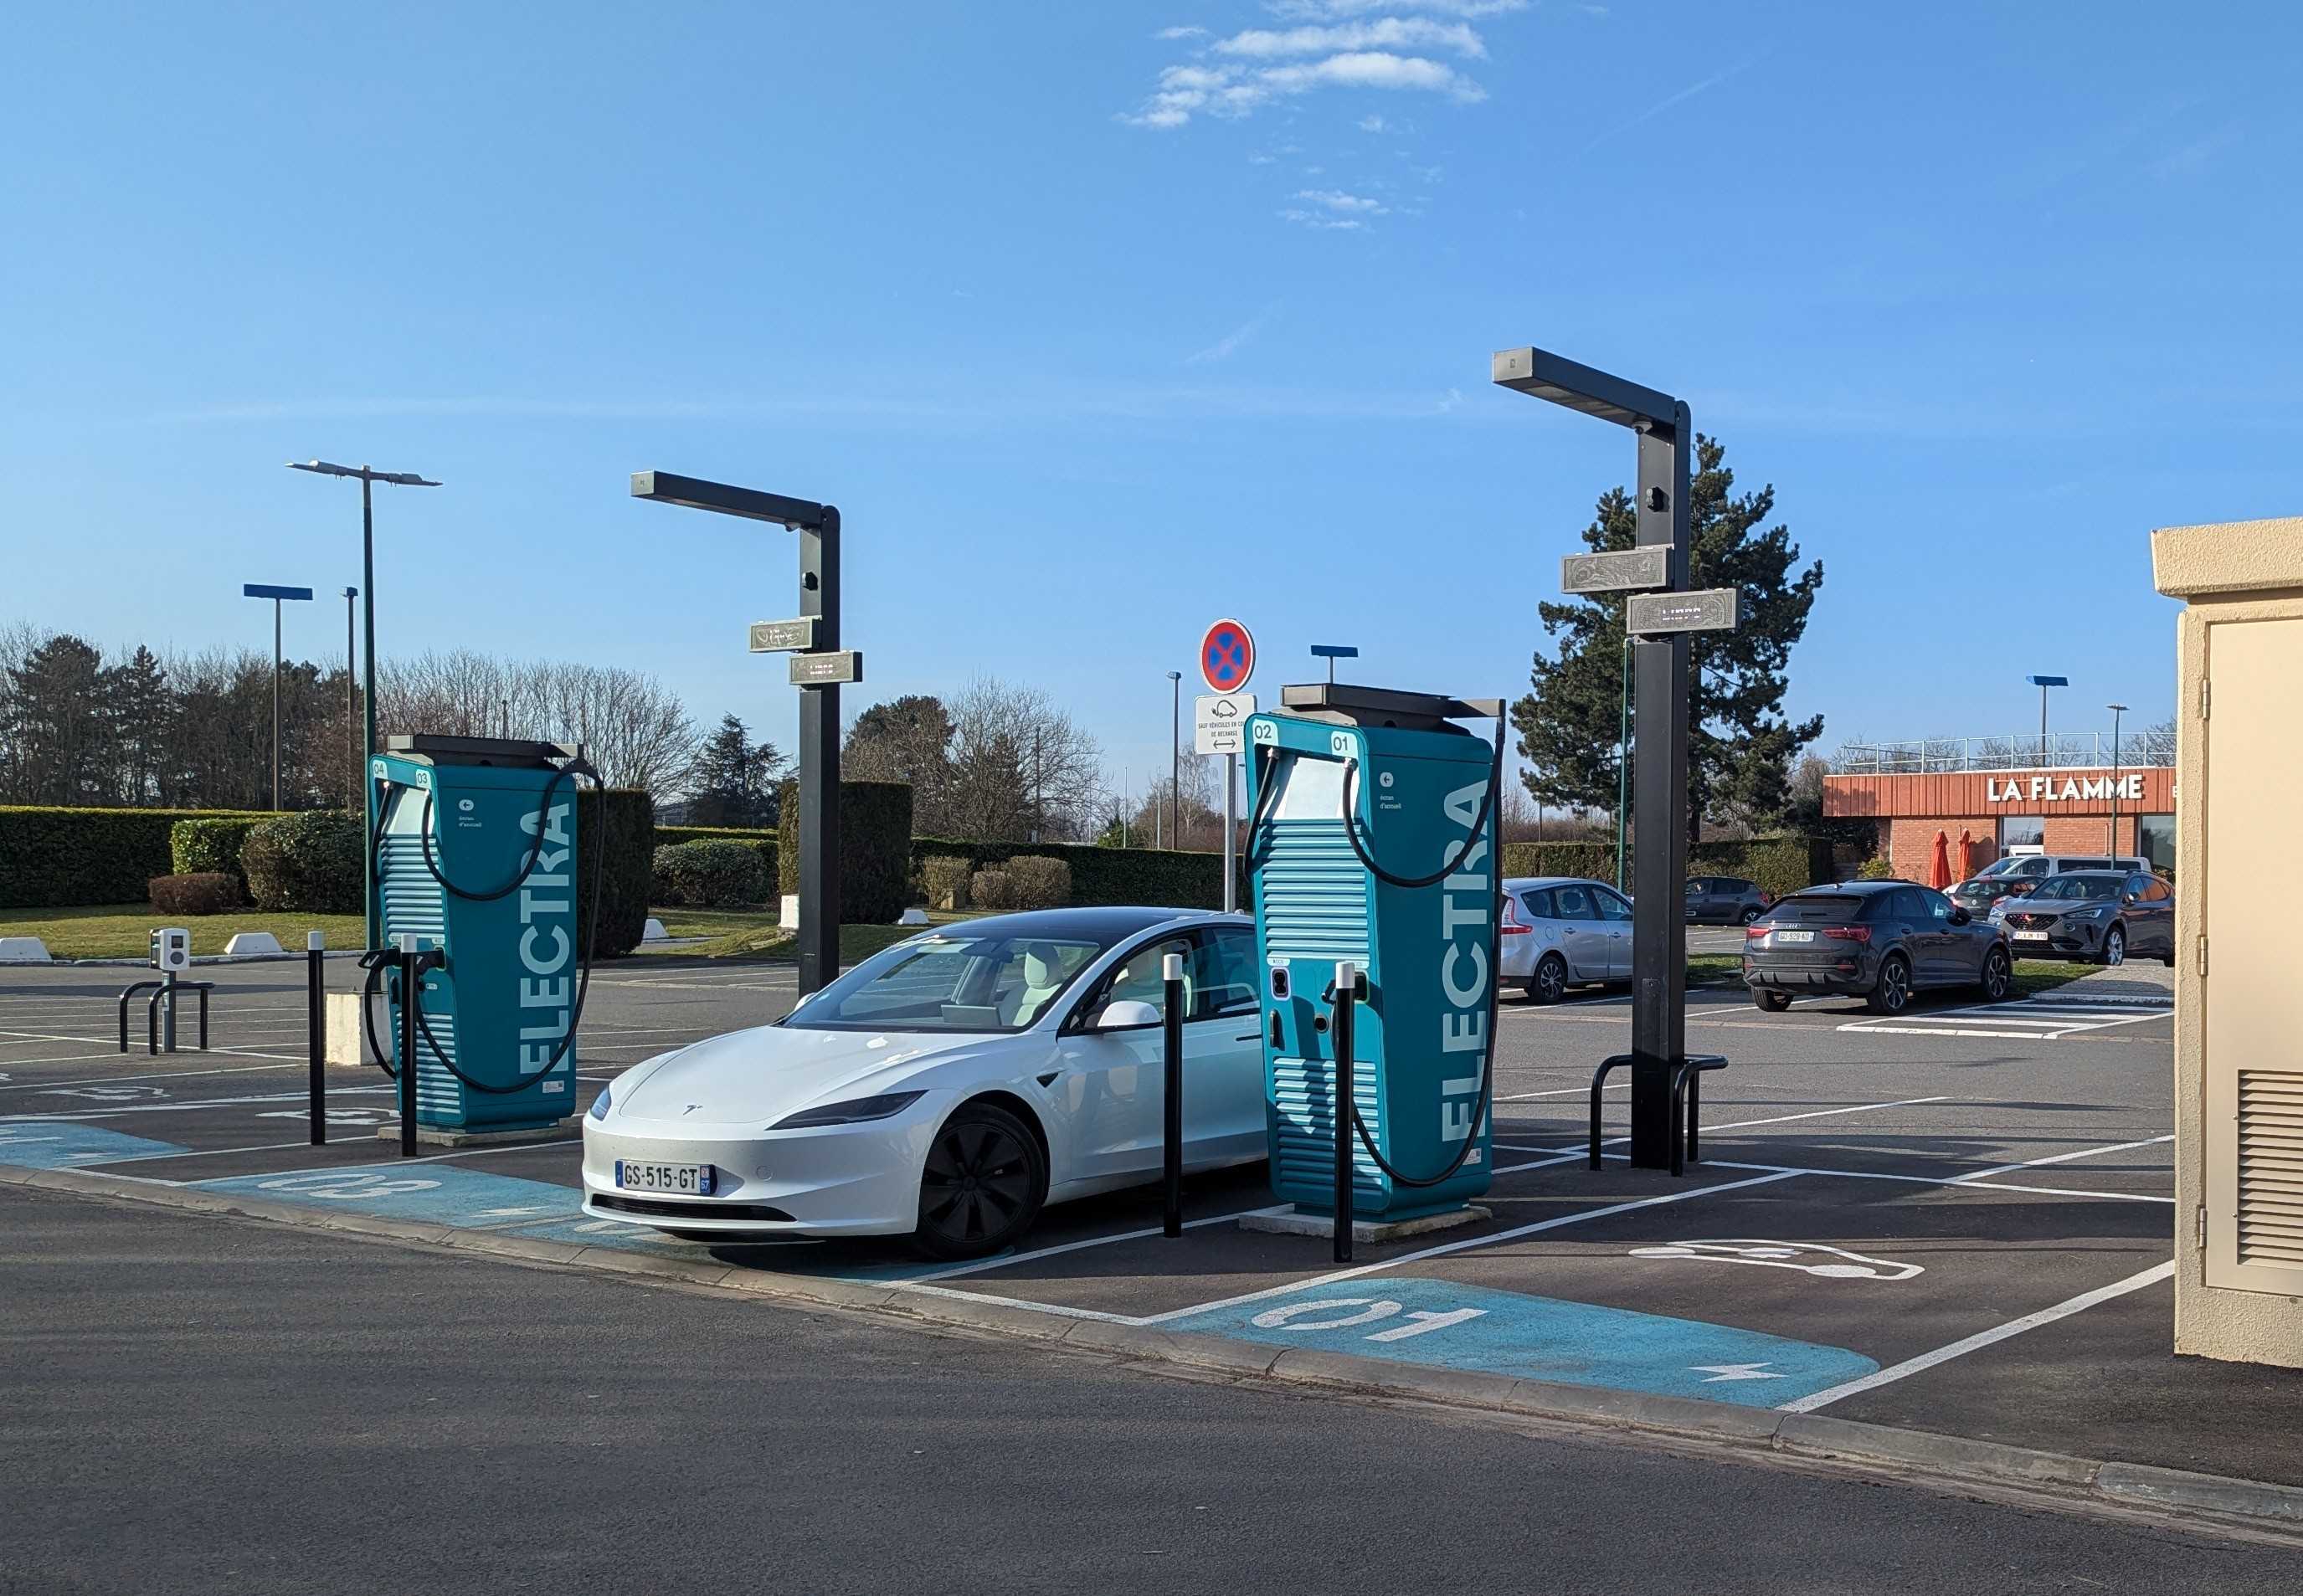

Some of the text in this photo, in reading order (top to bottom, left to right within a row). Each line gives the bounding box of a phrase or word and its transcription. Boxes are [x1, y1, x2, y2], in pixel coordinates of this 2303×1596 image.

[1254, 724, 1272, 739] 02
[1333, 736, 1349, 751] 01
[374, 762, 384, 774] 04
[417, 772, 428, 784] 03
[1987, 777, 2023, 801] LA
[2031, 773, 2143, 801] FLAMME
[520, 803, 570, 1075] ELECTRA
[1442, 778, 1488, 1142] ELECTRA
[258, 1173, 443, 1199] 03
[625, 1164, 698, 1189] GS-515-GT
[1251, 1298, 1489, 1342] 01
